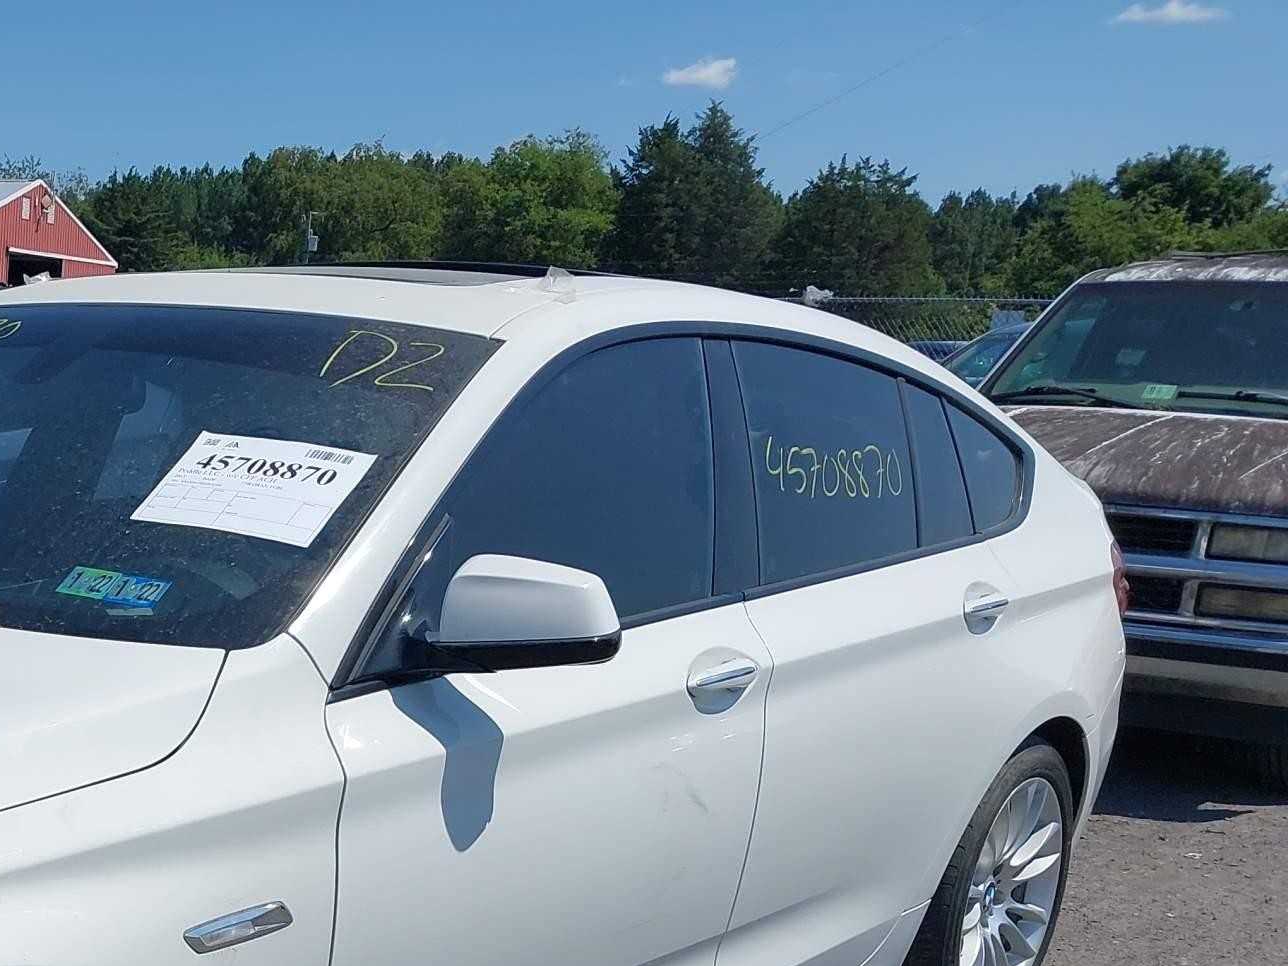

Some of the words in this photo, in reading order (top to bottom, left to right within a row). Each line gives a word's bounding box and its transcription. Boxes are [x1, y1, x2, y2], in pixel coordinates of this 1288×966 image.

[196, 453, 338, 486] 45708870
[766, 436, 903, 499] 45708870
[88, 575, 113, 594] 22
[136, 583, 161, 600] 22
